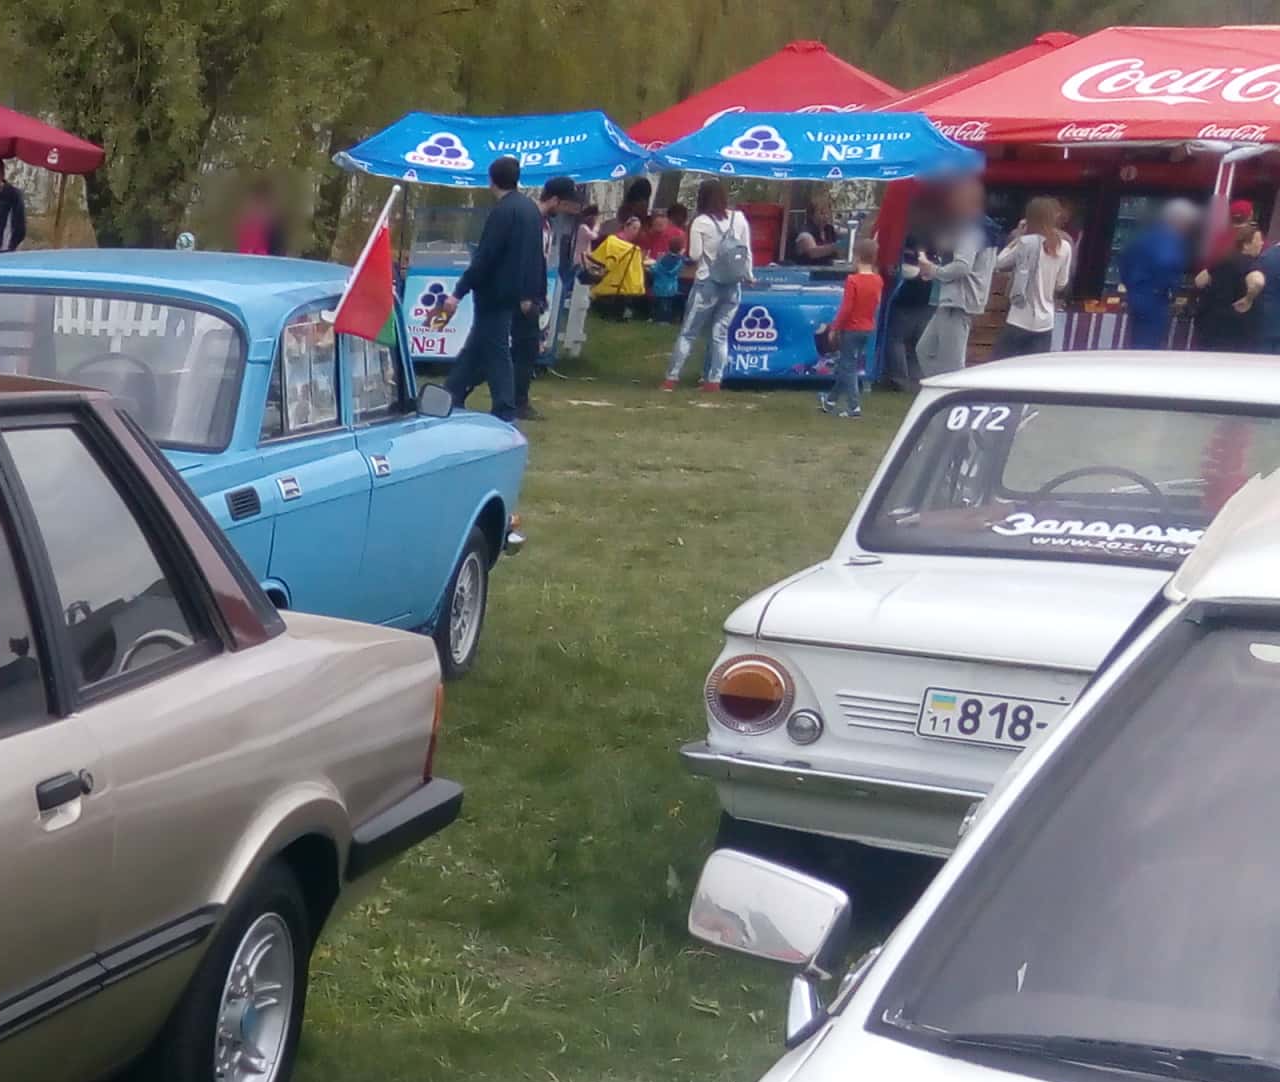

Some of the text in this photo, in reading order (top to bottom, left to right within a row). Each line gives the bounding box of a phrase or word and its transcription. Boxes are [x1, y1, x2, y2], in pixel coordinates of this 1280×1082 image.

[1061, 58, 1280, 105] Coca-C
[821, 143, 884, 161] №1
[737, 330, 775, 340] РУДЬ
[411, 336, 448, 355] №1
[736, 353, 770, 371] №1
[947, 406, 1010, 431] 072
[929, 715, 951, 733] 11
